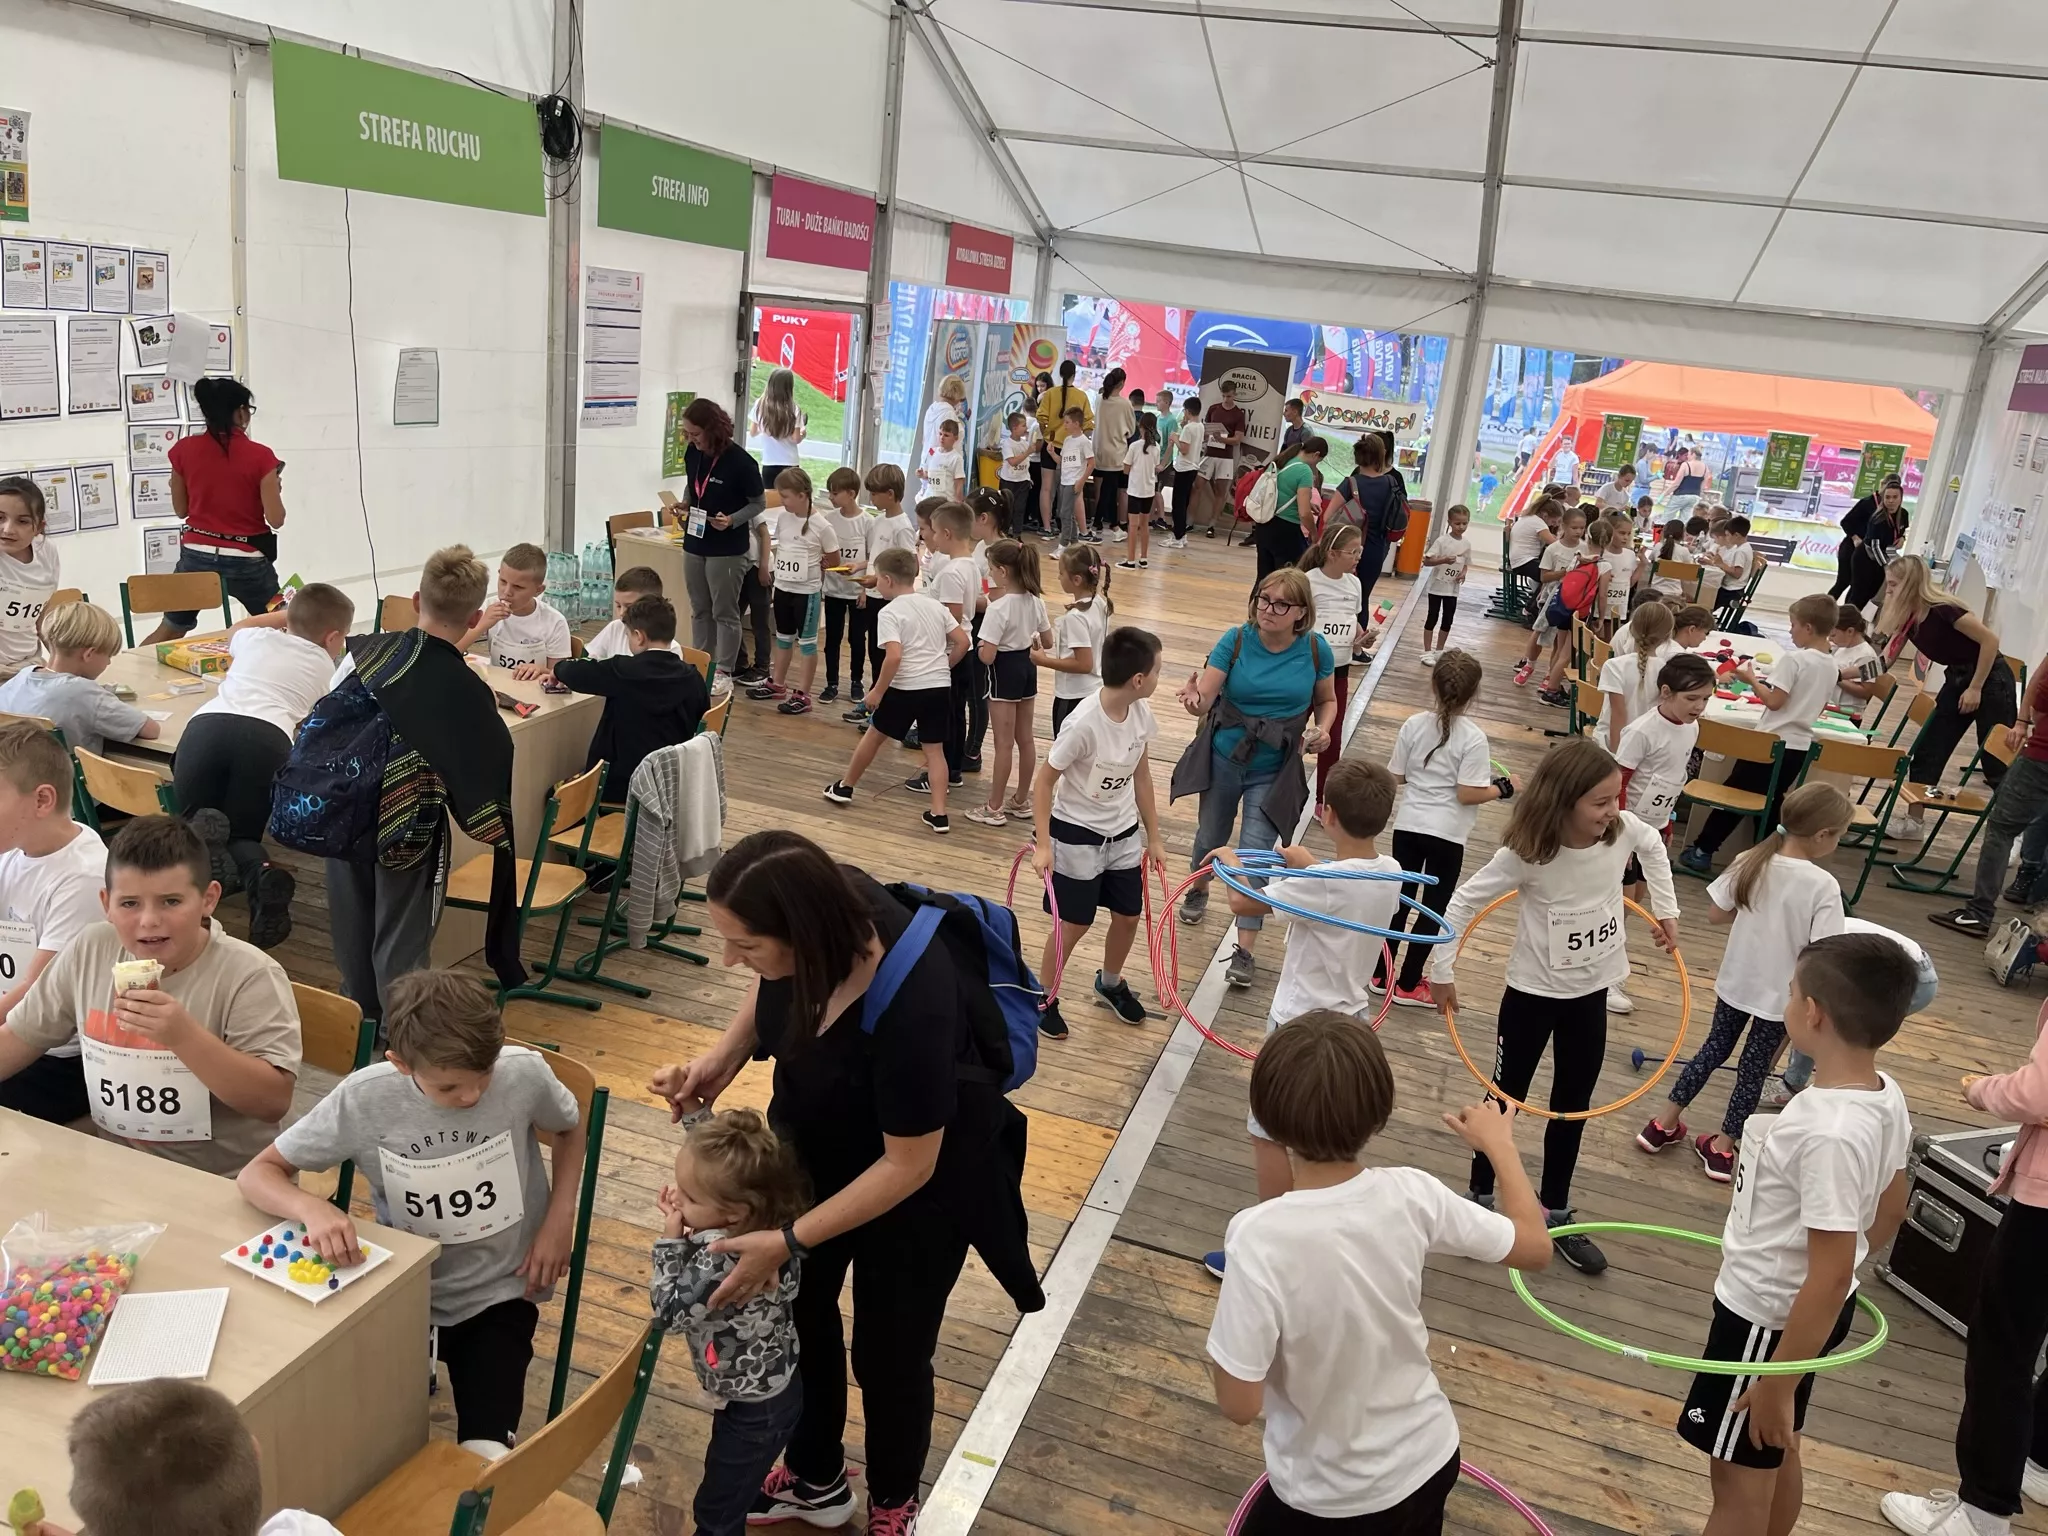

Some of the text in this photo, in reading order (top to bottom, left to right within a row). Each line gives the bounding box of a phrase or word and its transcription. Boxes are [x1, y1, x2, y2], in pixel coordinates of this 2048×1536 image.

[359, 111, 481, 162] STREFA RUCHU
[651, 175, 710, 208] STREFA INFO
[776, 206, 801, 229] TUBAN
[804, 211, 822, 234] DUŻE
[822, 216, 843, 237] BAŃKI
[844, 221, 869, 242] RADOŚCI
[978, 252, 994, 267] STREFA
[772, 314, 809, 326] PUKY
[1231, 372, 1257, 381] BRACIA
[1235, 381, 1257, 392] ORAL
[928, 477, 941, 485] 218
[839, 548, 859, 559] 127
[776, 559, 800, 573] 5210
[1444, 568, 1460, 577] 507
[5, 600, 43, 619] 518
[1323, 623, 1351, 636] 5077
[1100, 773, 1133, 790] 52
[1651, 794, 1679, 809] 51
[1567, 916, 1618, 951] 5159
[100, 1077, 181, 1115] 5188
[404, 1179, 497, 1220] 5193
